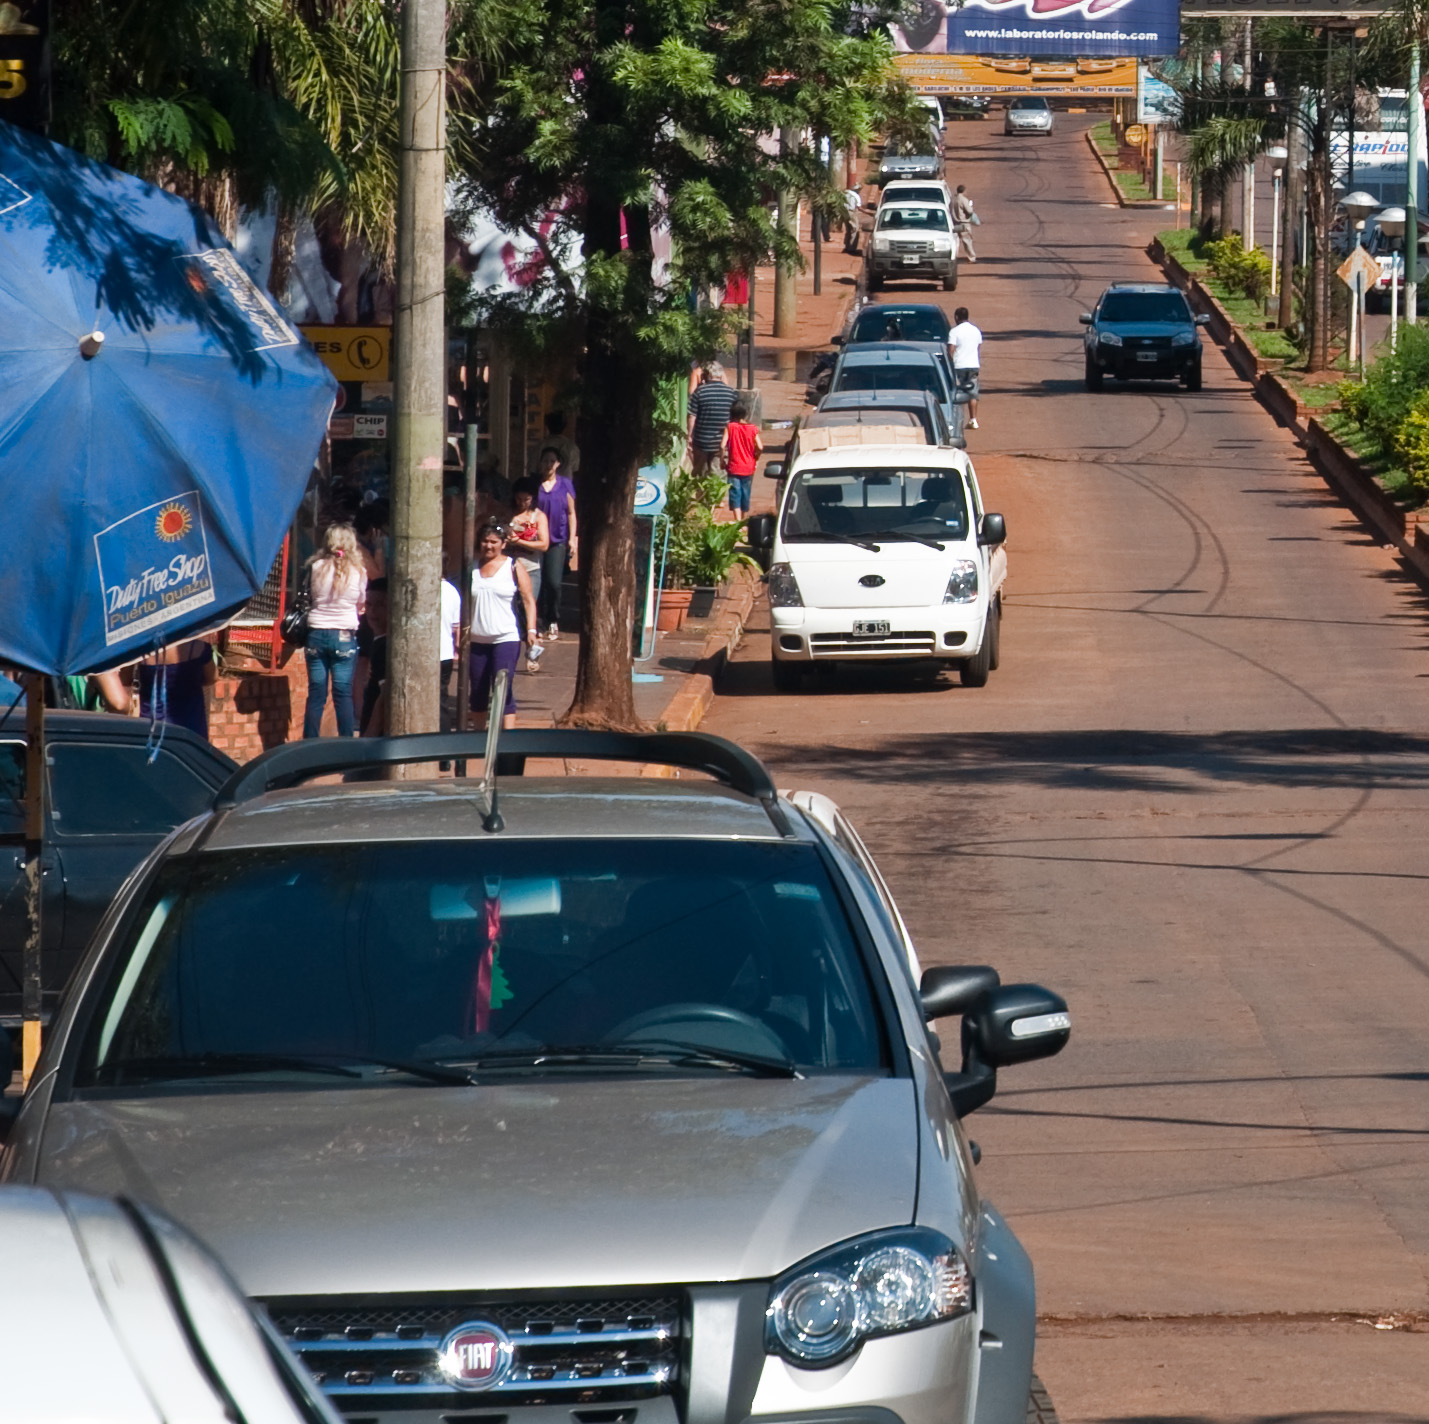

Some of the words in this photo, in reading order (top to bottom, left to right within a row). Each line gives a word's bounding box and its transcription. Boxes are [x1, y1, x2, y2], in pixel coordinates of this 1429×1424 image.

[965, 27, 1158, 42] www.laboratoriosrolando.com
[106, 578, 142, 613] Duty
[140, 566, 169, 598] Free
[168, 554, 205, 586] Shop
[110, 599, 157, 629] Puerto
[458, 1342, 495, 1370] FIAT
